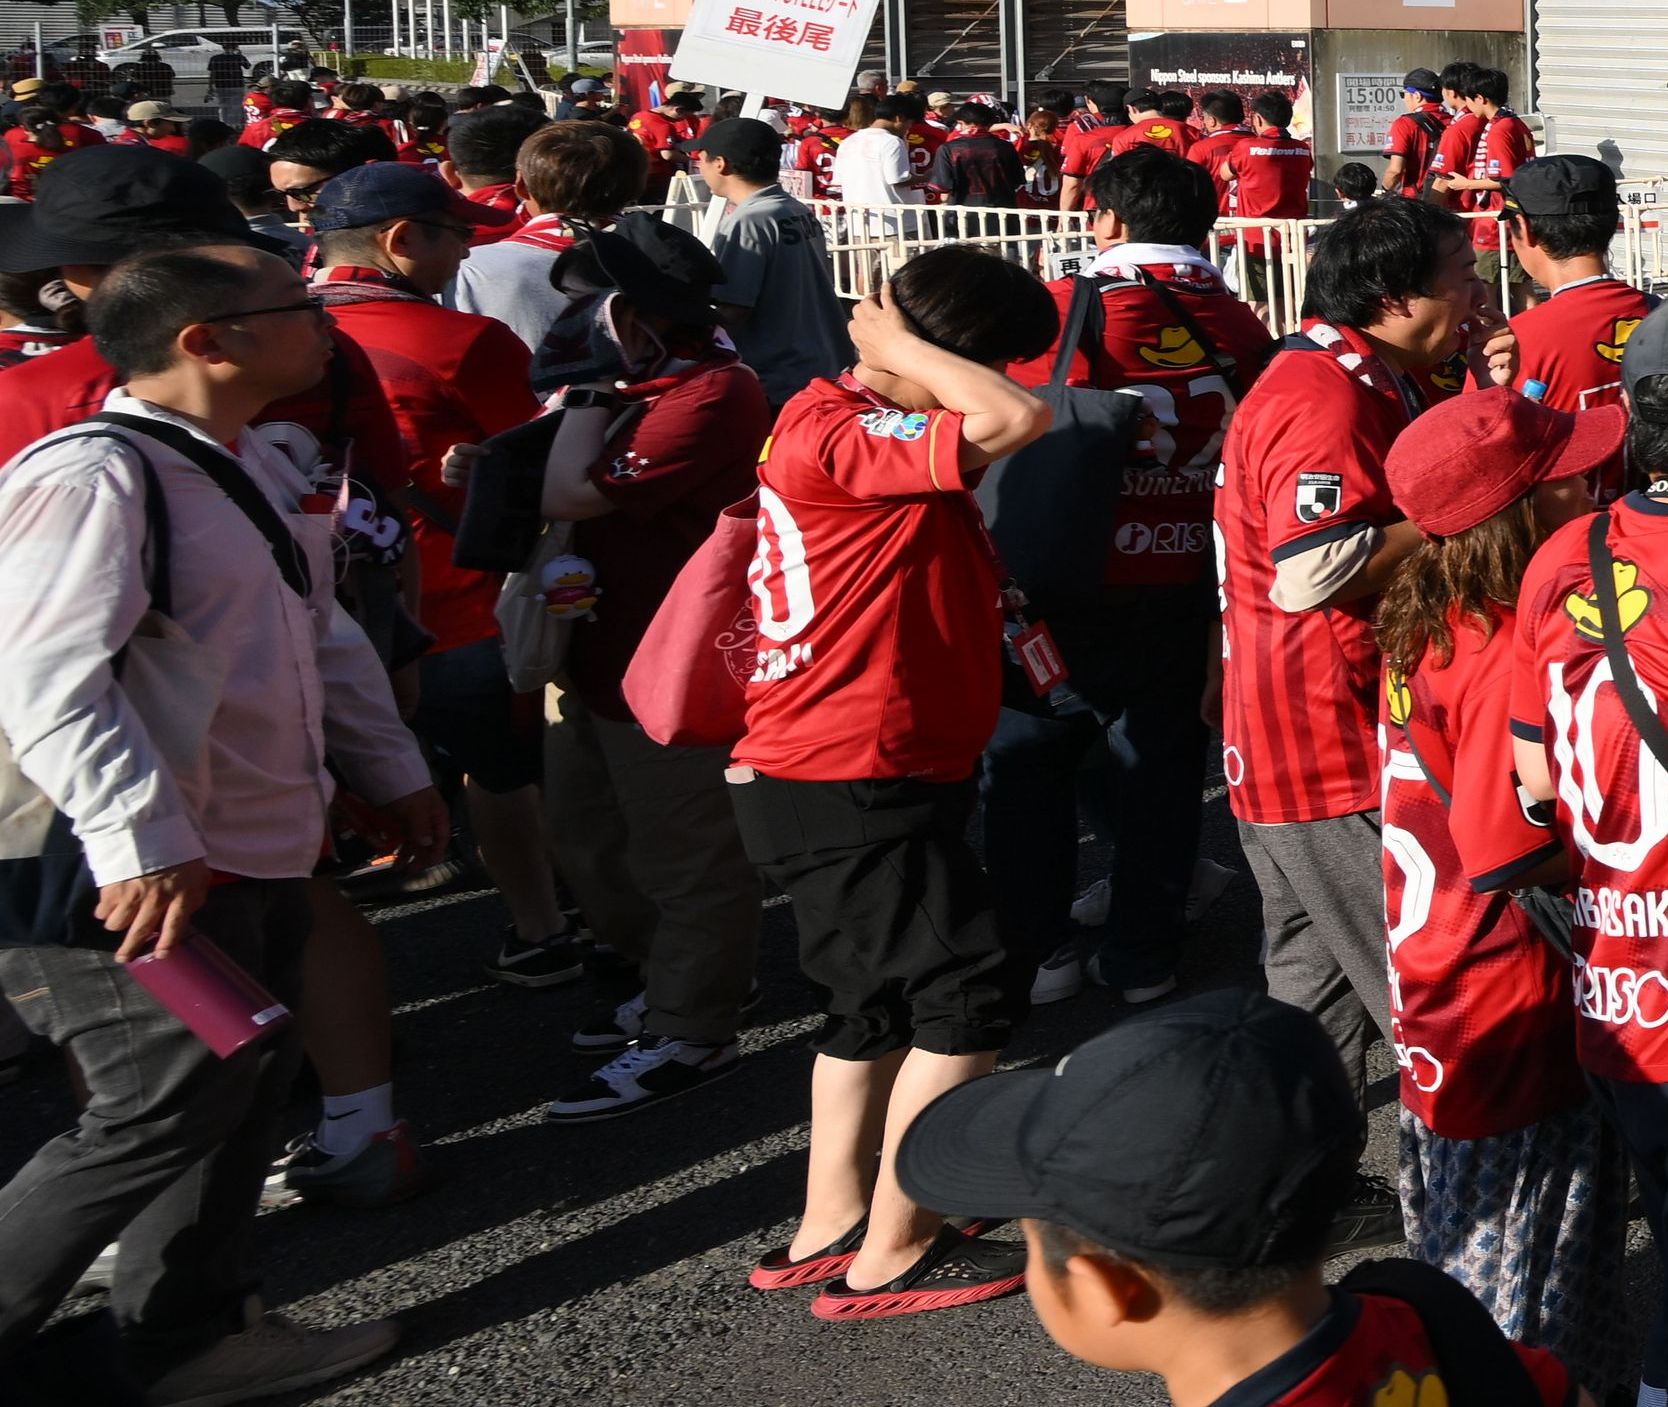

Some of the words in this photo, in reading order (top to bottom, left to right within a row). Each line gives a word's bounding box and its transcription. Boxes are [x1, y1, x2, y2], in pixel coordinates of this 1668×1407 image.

[724, 6, 836, 53] 最後尾
[1346, 87, 1396, 104] 15:00
